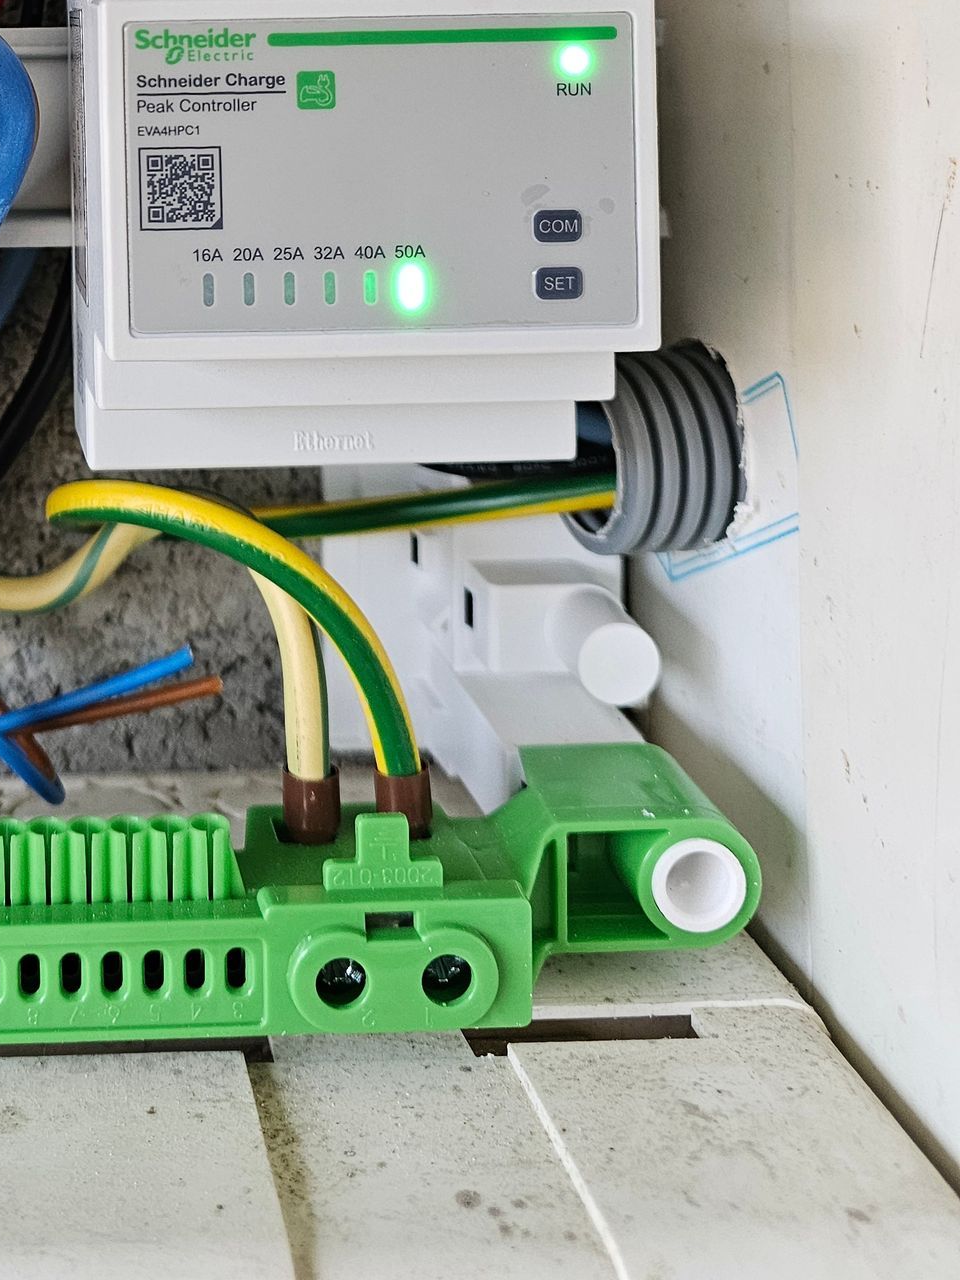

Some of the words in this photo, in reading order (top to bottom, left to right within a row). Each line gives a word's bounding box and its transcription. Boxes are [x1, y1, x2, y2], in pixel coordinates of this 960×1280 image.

[134, 28, 257, 51] Schneider
[187, 50, 254, 62] Electric
[136, 74, 221, 89] Schneider
[225, 73, 286, 89] Charge
[556, 82, 592, 97] RUN
[136, 98, 175, 113] Peak
[179, 97, 257, 113] Controller
[137, 125, 201, 137] EVA4HPC1
[539, 219, 579, 234] COM
[192, 248, 224, 262] 16A
[232, 247, 265, 262] 20A
[273, 246, 305, 261] 25A
[313, 246, 345, 260] 32A
[354, 245, 386, 260] 40A
[394, 244, 427, 259] 50A
[543, 276, 576, 291] SET
[292, 430, 375, 453] Ethernet
